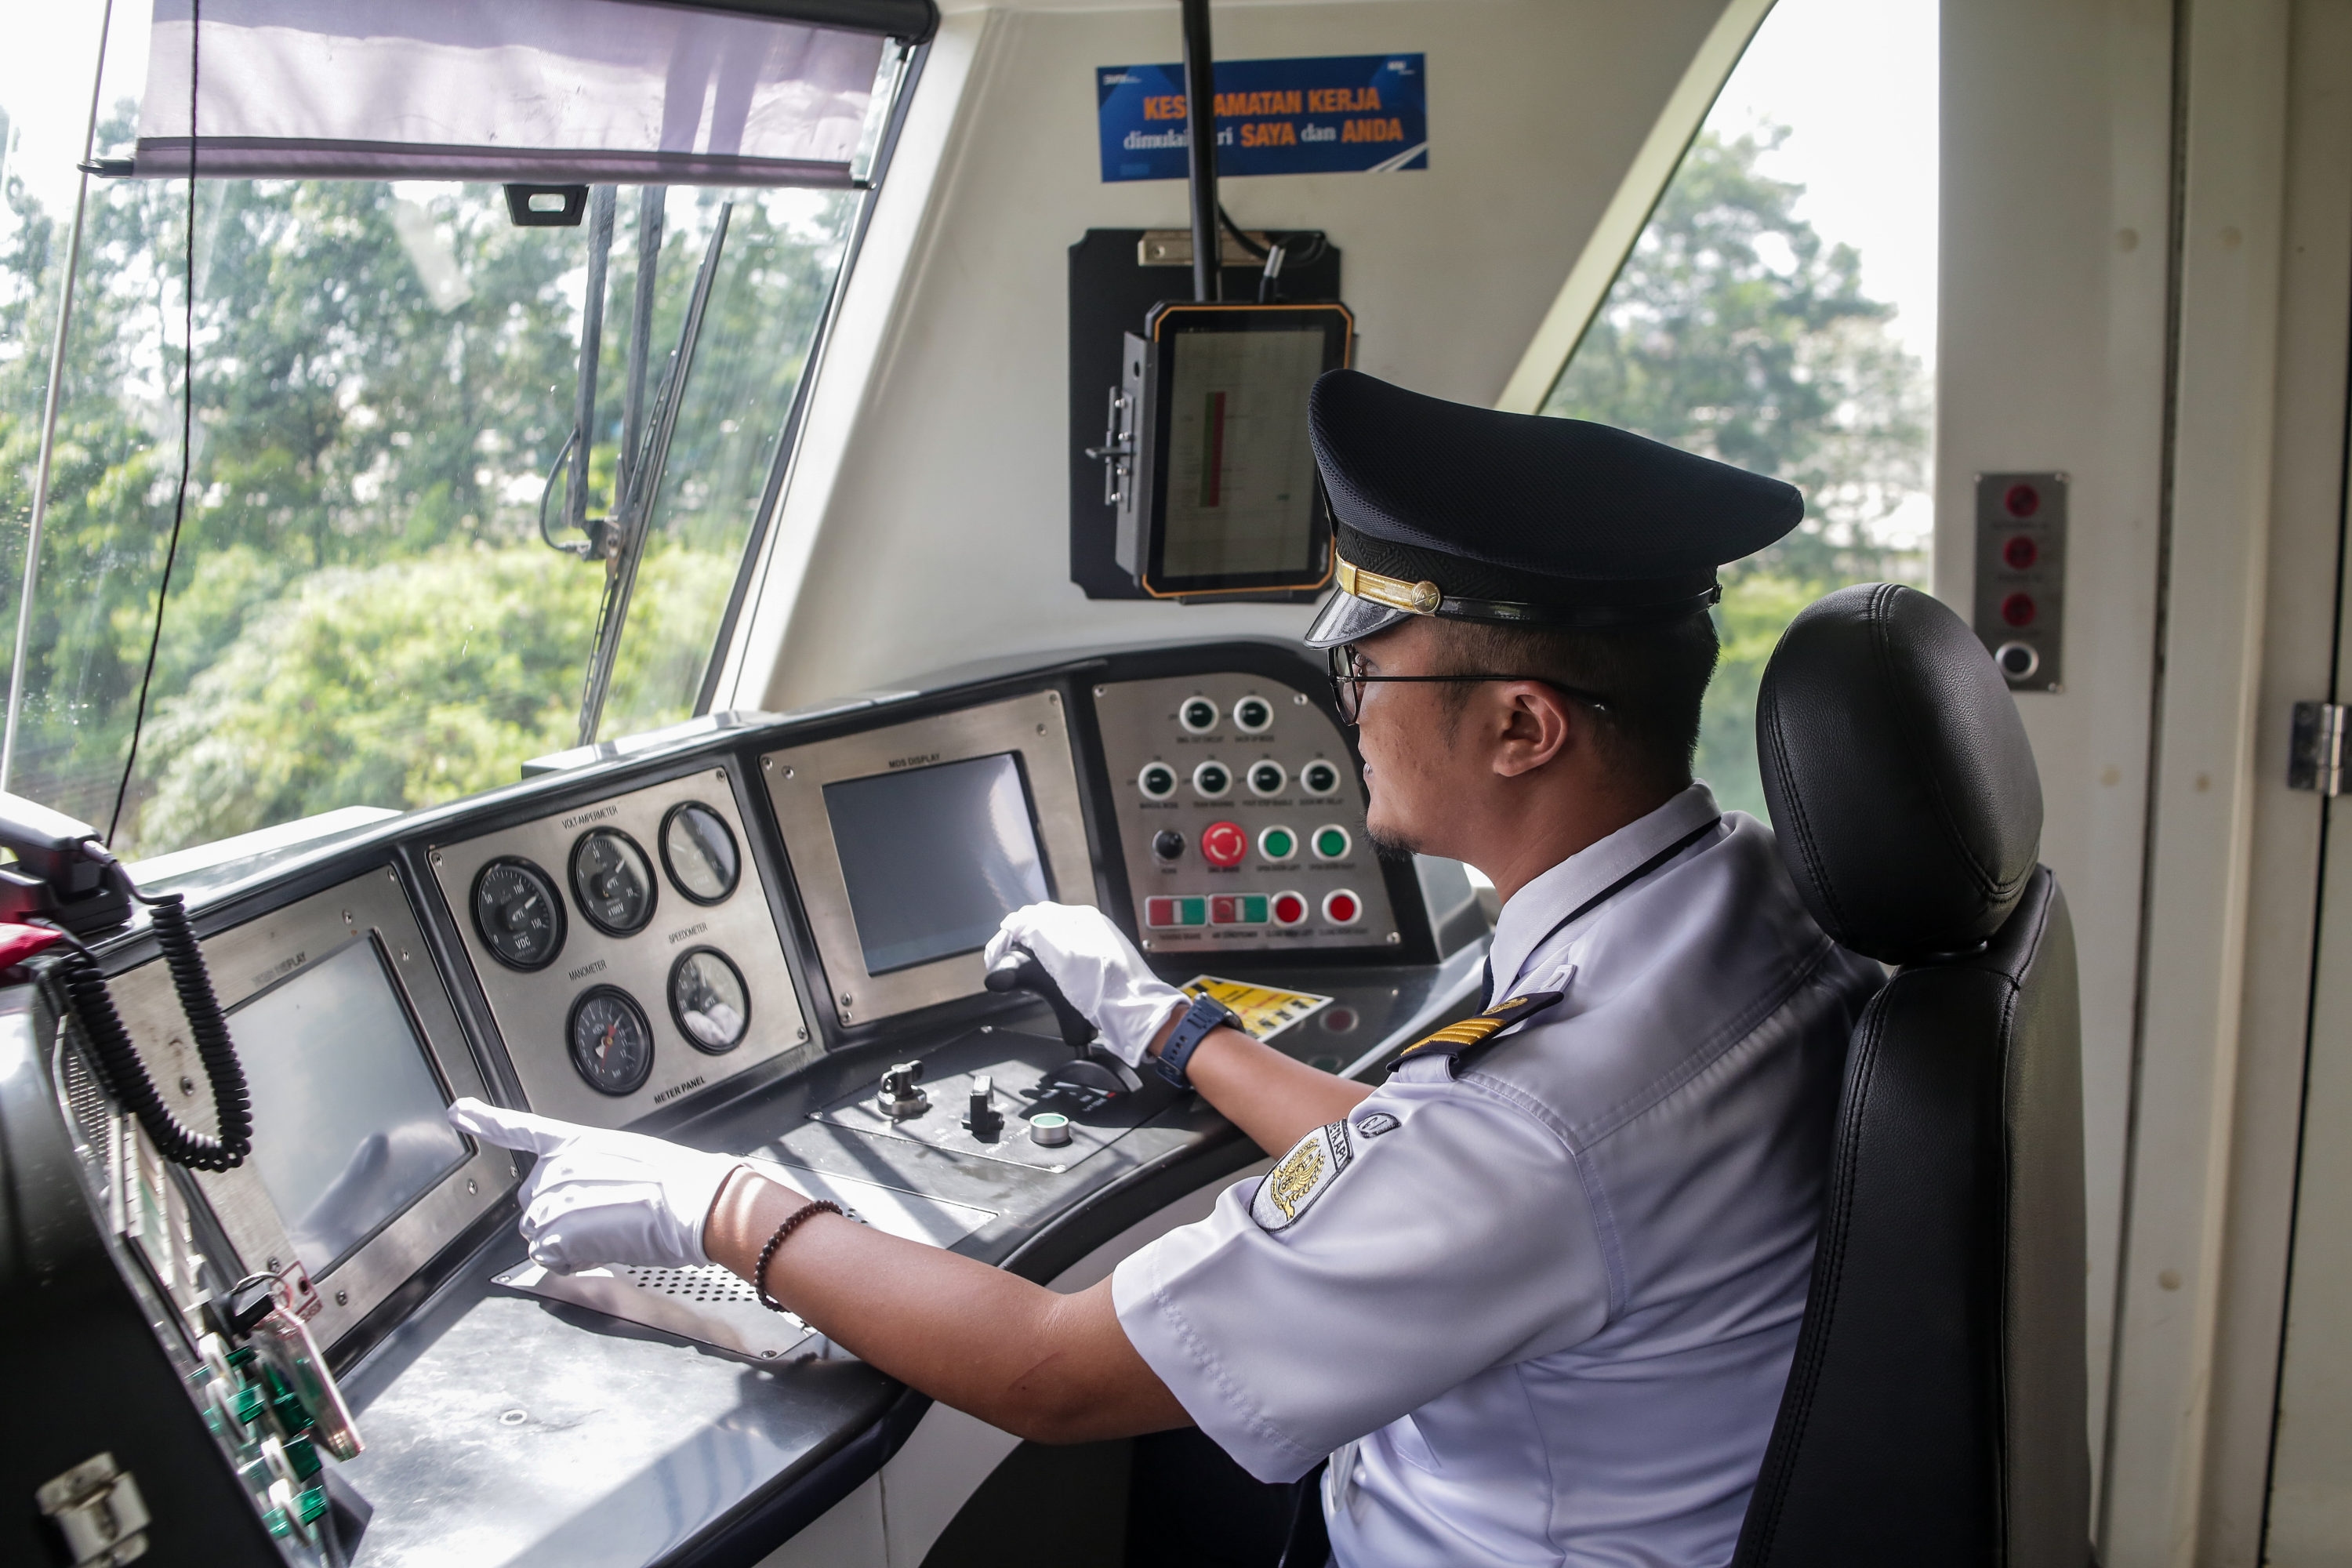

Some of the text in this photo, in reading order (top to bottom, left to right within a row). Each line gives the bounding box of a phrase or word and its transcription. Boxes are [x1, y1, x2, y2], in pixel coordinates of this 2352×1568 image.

[1143, 87, 1381, 120] KESAMATAN KERJA
[1240, 122, 1297, 147] SAYA
[1301, 124, 1336, 143] dan
[1341, 118, 1403, 143] ANDA
[908, 753, 940, 765] DISPLAY
[515, 936, 531, 949] VDC
[669, 922, 708, 944] SPEEDOMETER
[274, 951, 307, 976] PLAY
[568, 960, 607, 981] MANOMETER
[654, 1076, 706, 1105] METER PANEL
